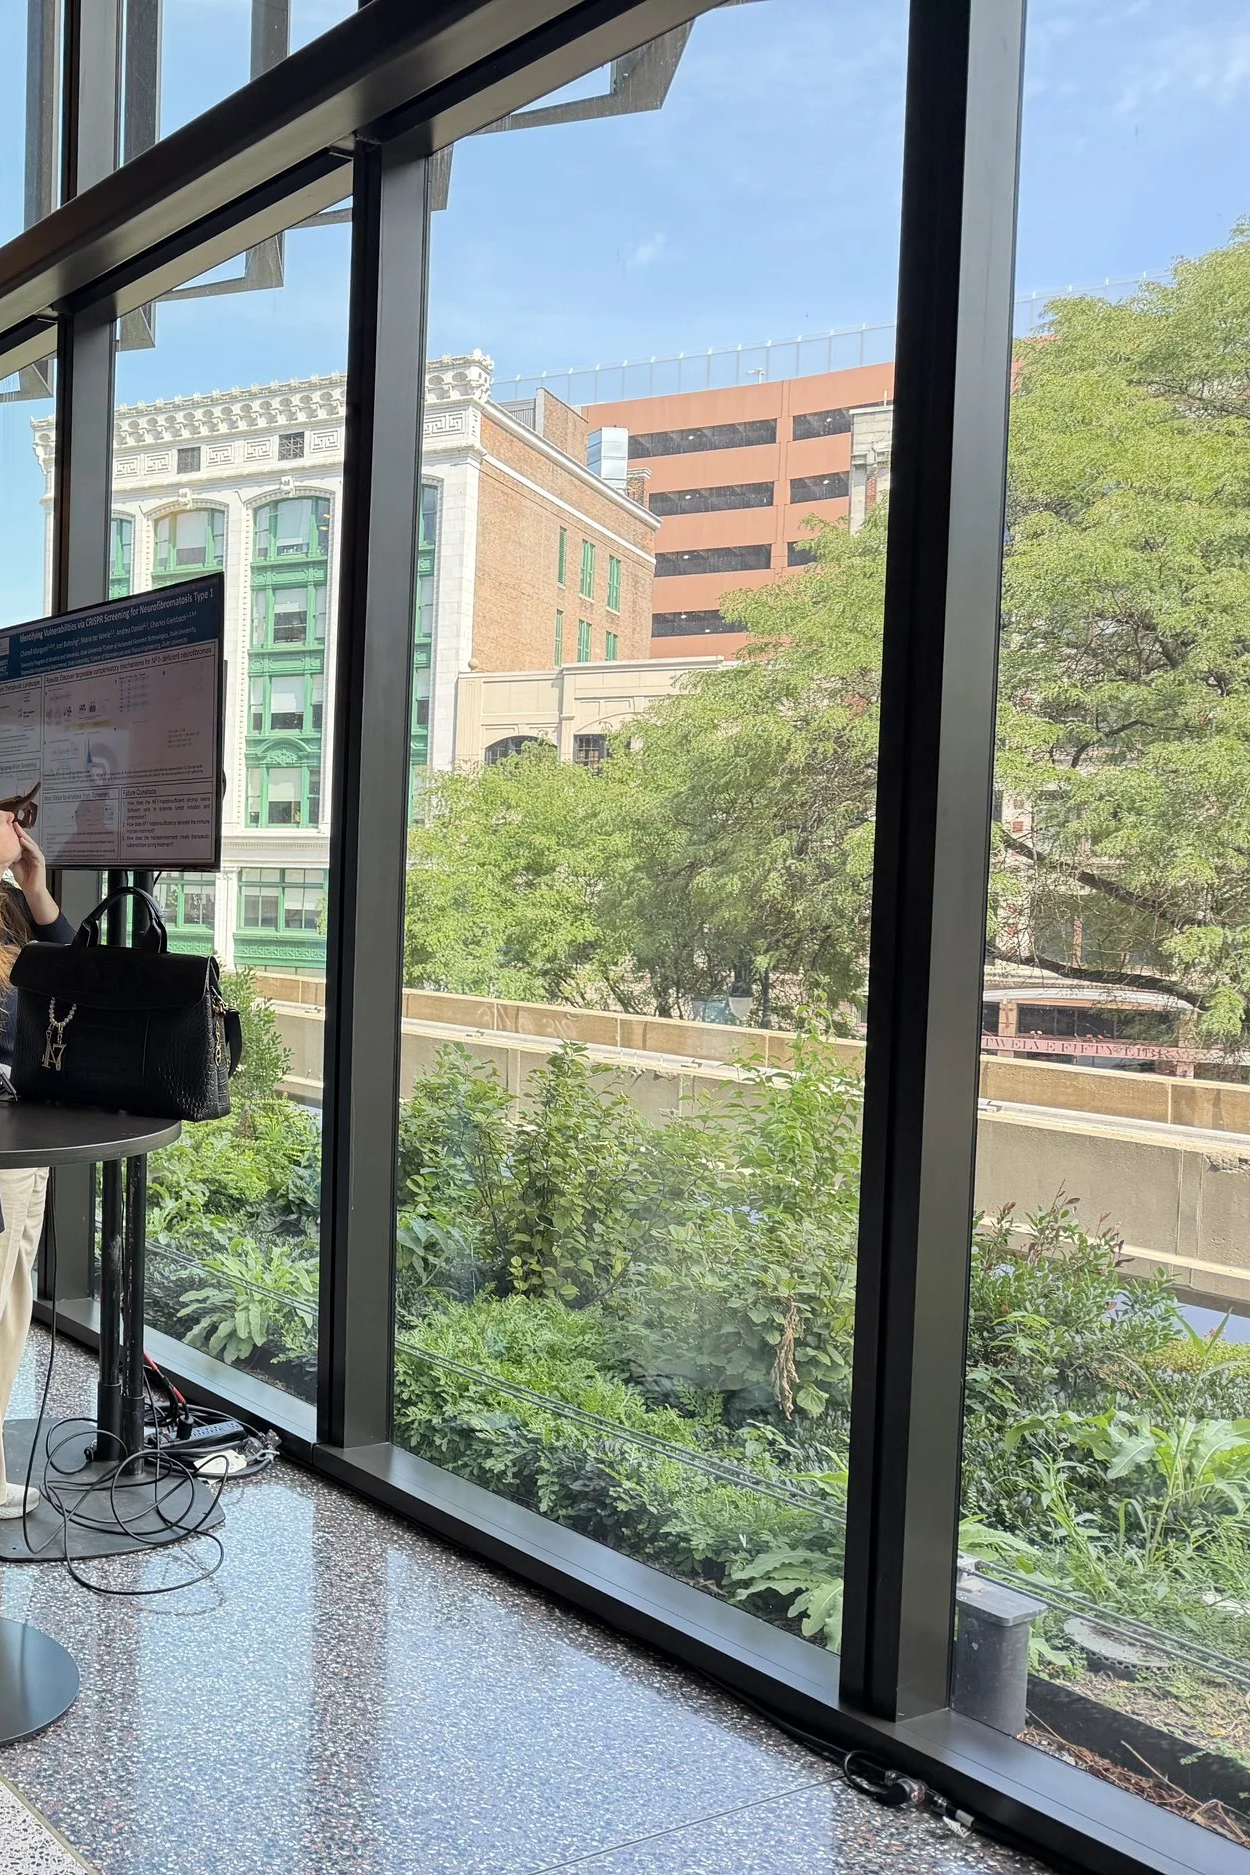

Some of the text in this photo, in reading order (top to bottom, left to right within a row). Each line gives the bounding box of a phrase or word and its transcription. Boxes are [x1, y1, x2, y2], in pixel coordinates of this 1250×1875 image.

[19, 630, 43, 643] Identifying
[43, 622, 76, 637] Vulnerabilities
[86, 615, 103, 627] CRISPR
[104, 609, 129, 623] Screening
[130, 606, 138, 616] for
[139, 594, 192, 614] Neurofibromatosis
[194, 590, 208, 602] Type
[180, 646, 211, 658] neurofibromas
[1061, 1042, 1114, 1056] FIFTY
